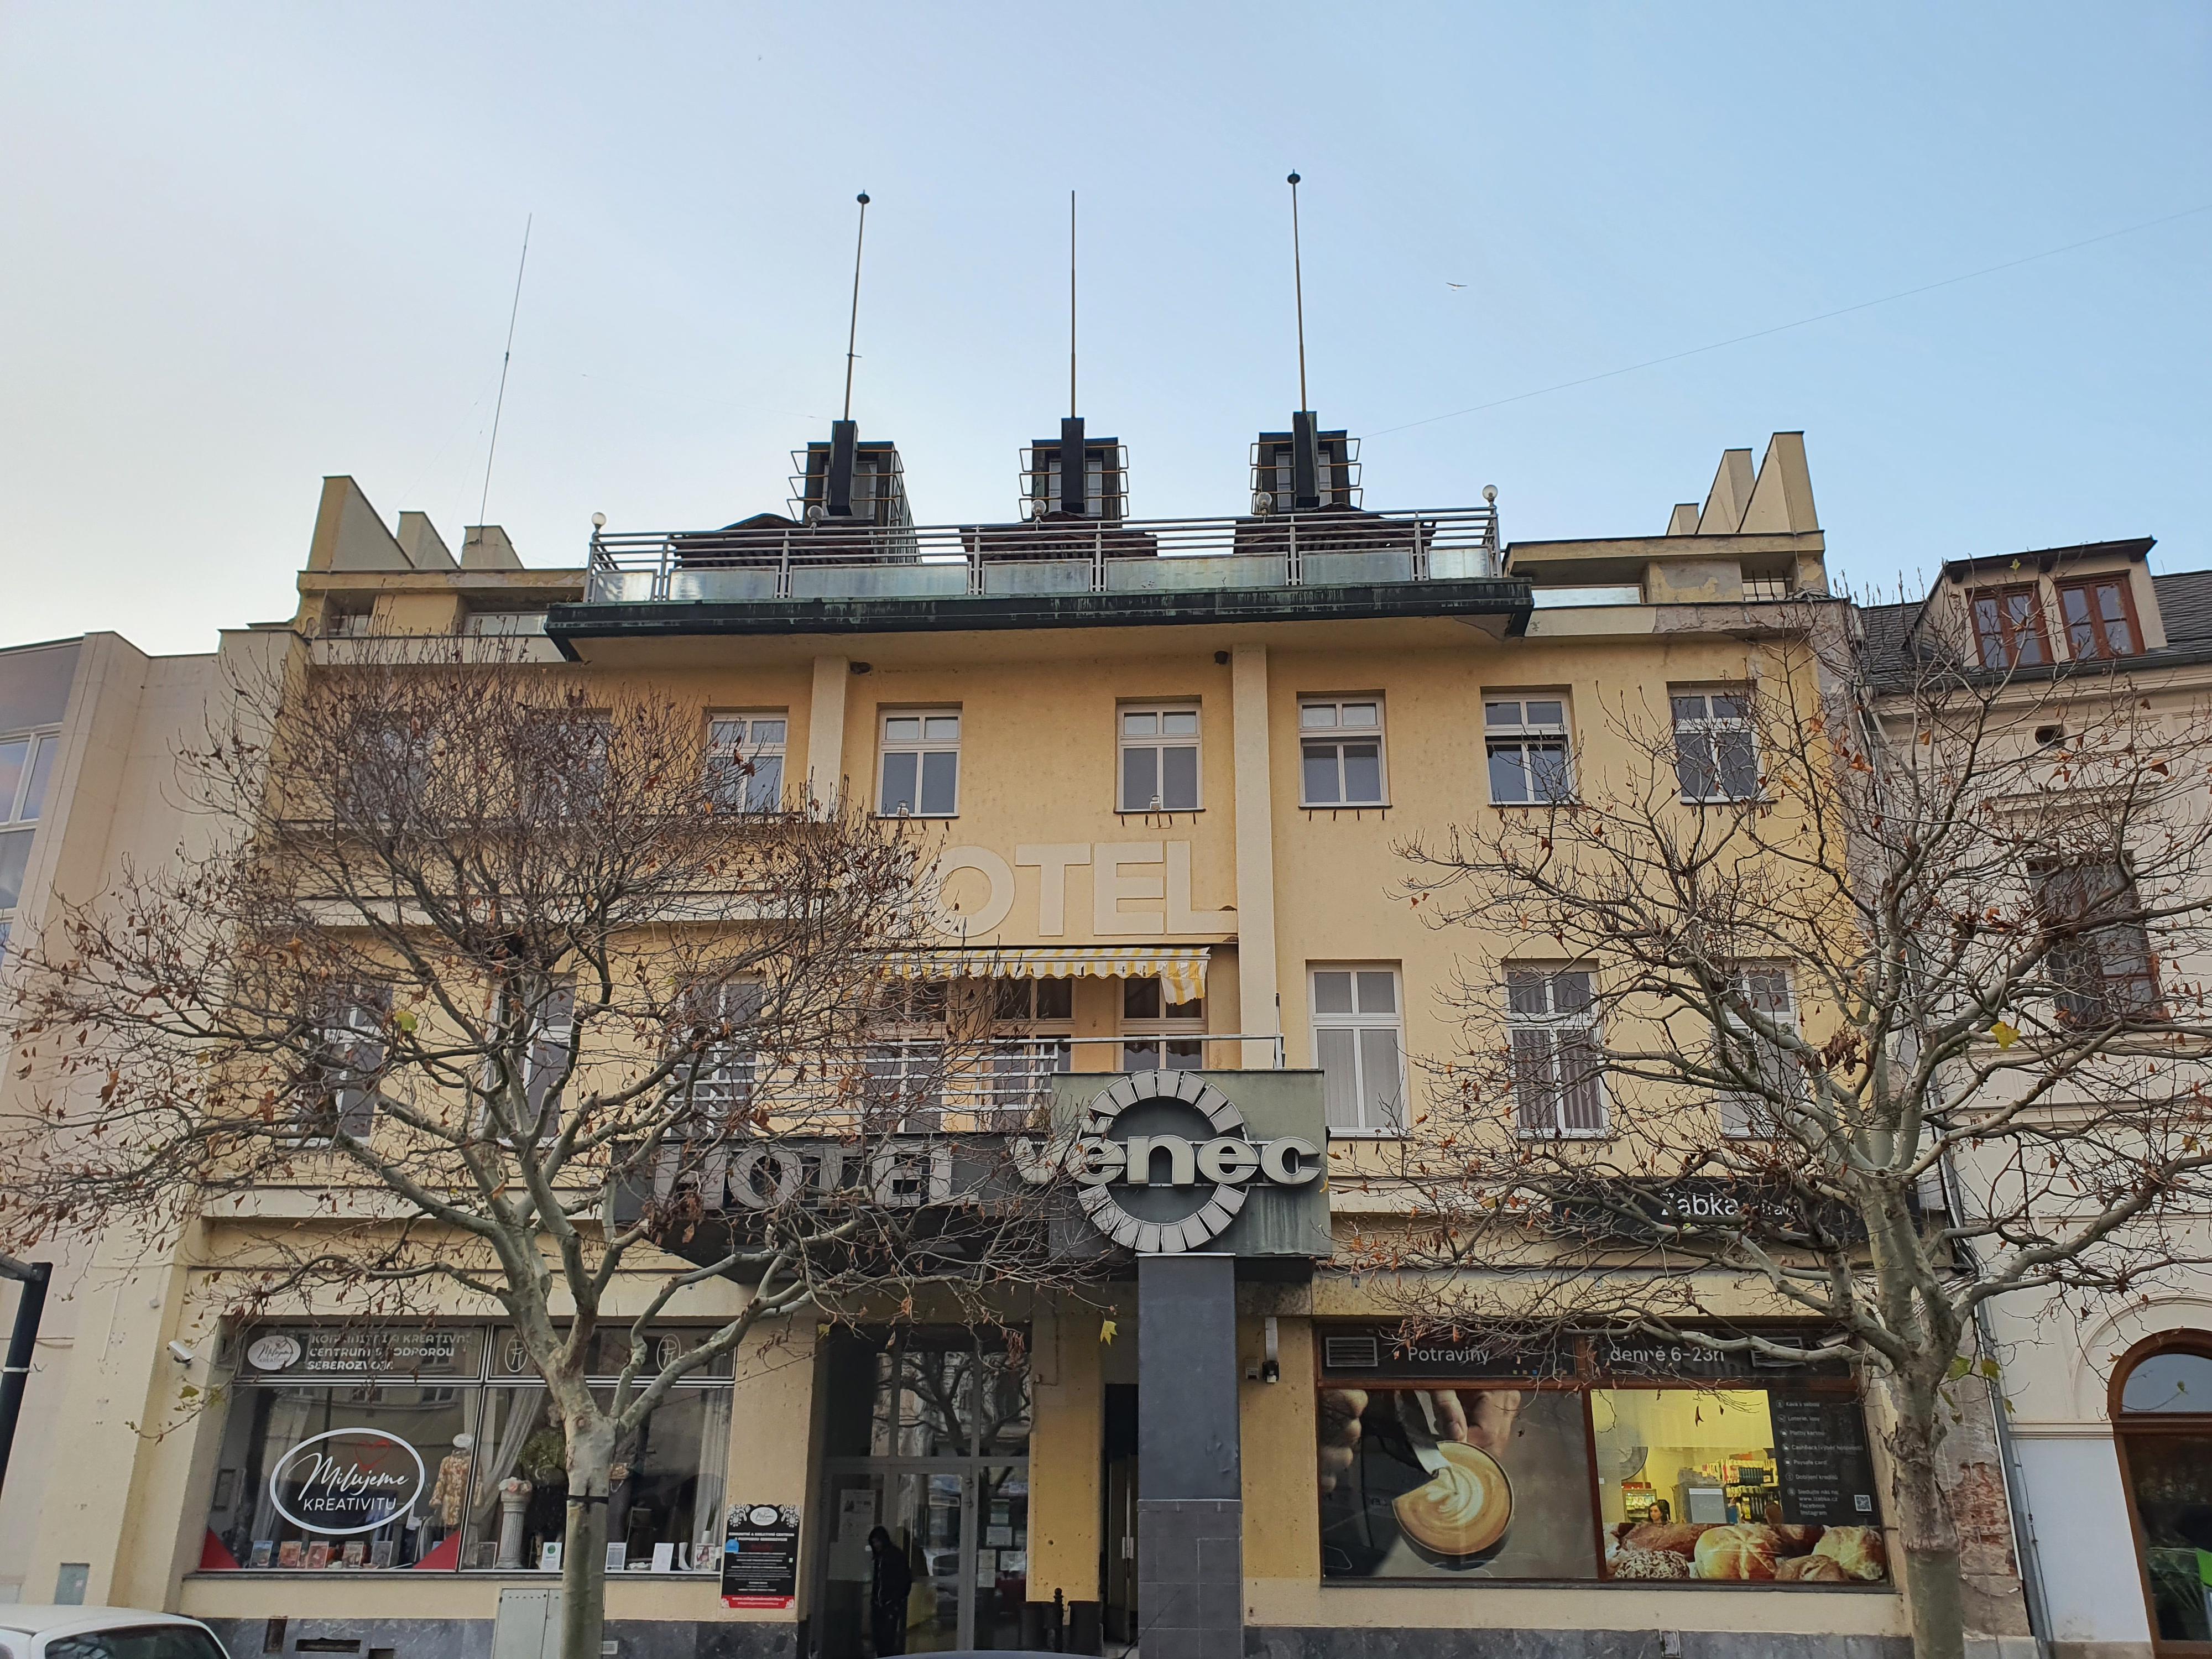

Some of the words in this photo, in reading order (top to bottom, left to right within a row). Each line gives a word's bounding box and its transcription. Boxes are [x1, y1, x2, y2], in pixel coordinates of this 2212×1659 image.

[654, 1142, 979, 1209] HOTEL
[1005, 1117, 1322, 1185] věnec
[309, 1347, 371, 1357] CENTRUM
[386, 1347, 455, 1357] ODPOROU
[1408, 1346, 1490, 1365] Potraviny
[286, 1452, 409, 1500] Milujeme
[304, 1498, 397, 1511] KREATIVITU
